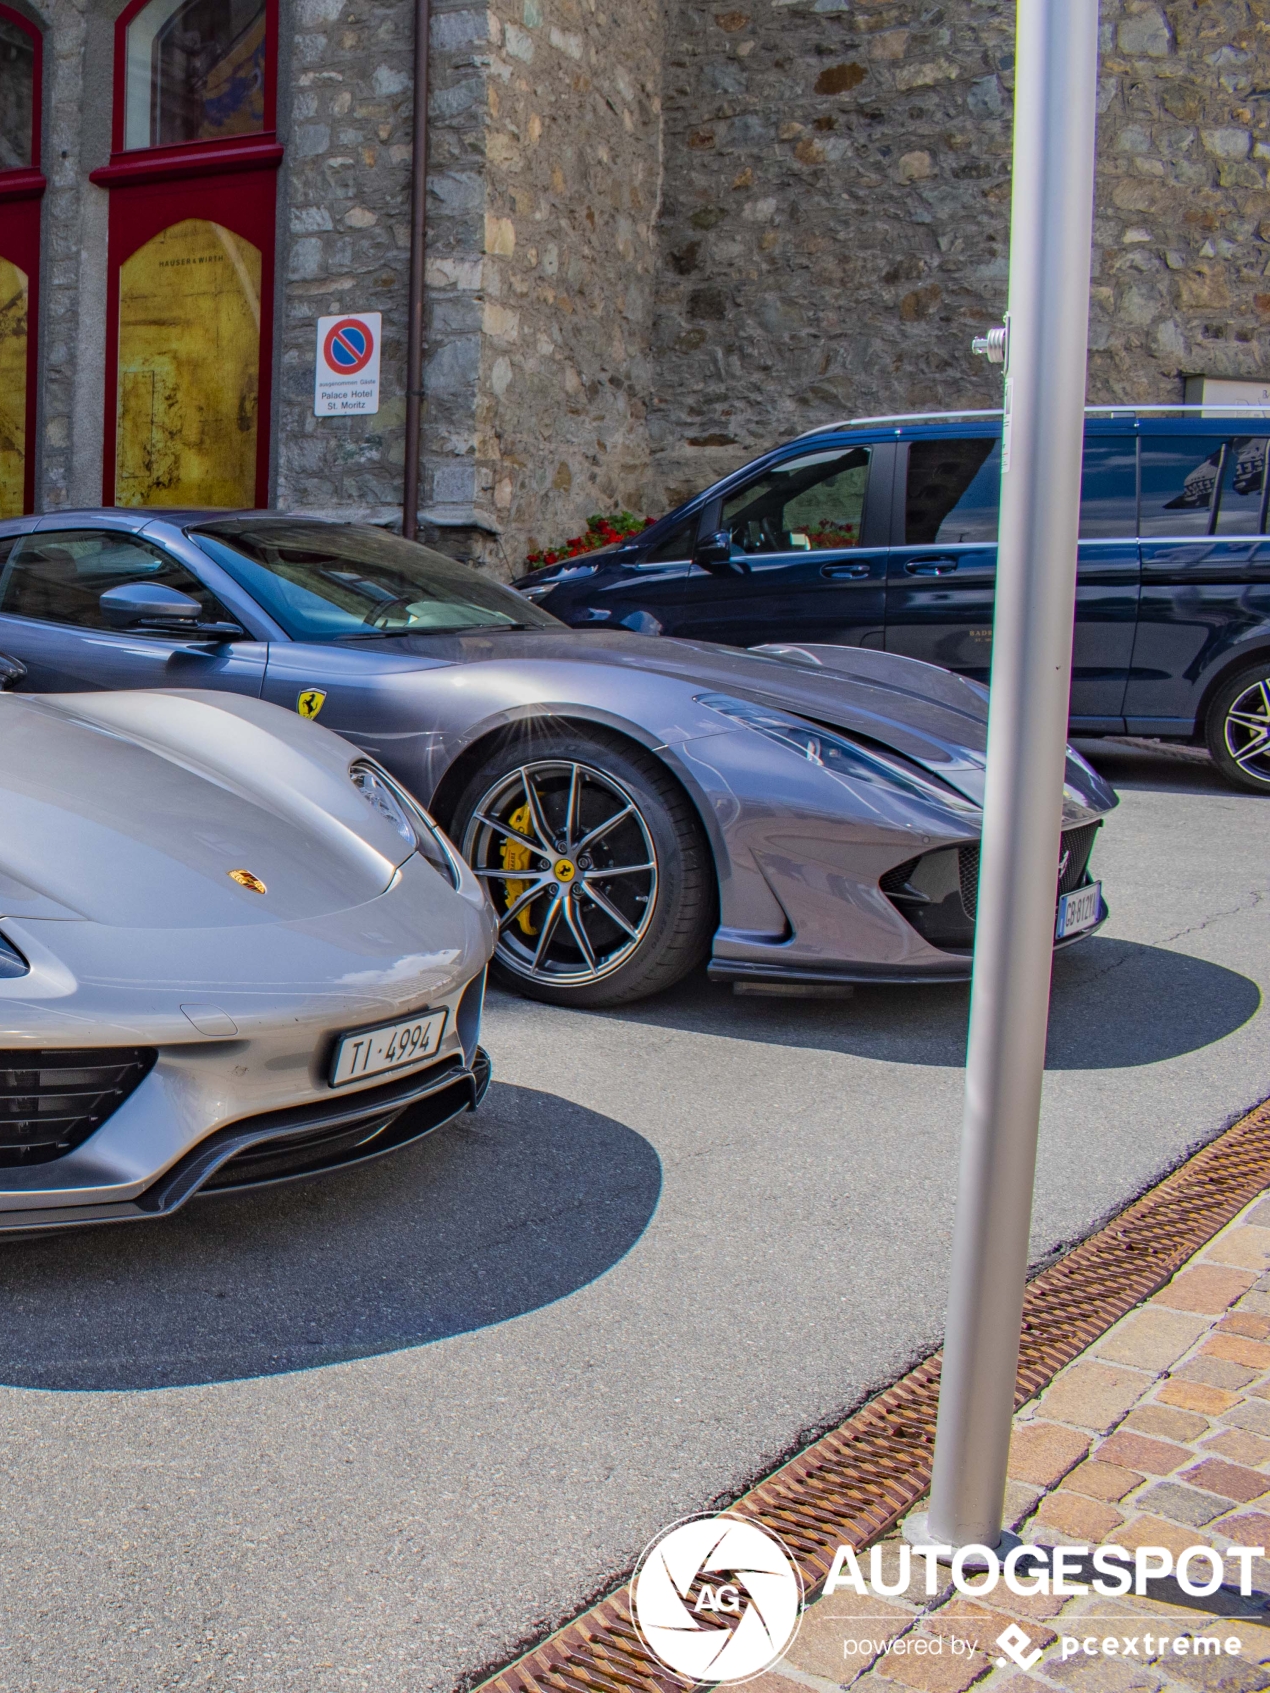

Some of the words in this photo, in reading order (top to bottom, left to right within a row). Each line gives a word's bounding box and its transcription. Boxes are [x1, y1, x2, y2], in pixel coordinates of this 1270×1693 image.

[158, 257, 191, 267] HAUSER
[198, 255, 224, 264] WIRTH
[321, 391, 348, 400] Palace
[351, 389, 373, 398] Hotel
[327, 402, 338, 411] St.
[341, 401, 366, 410] Moritz
